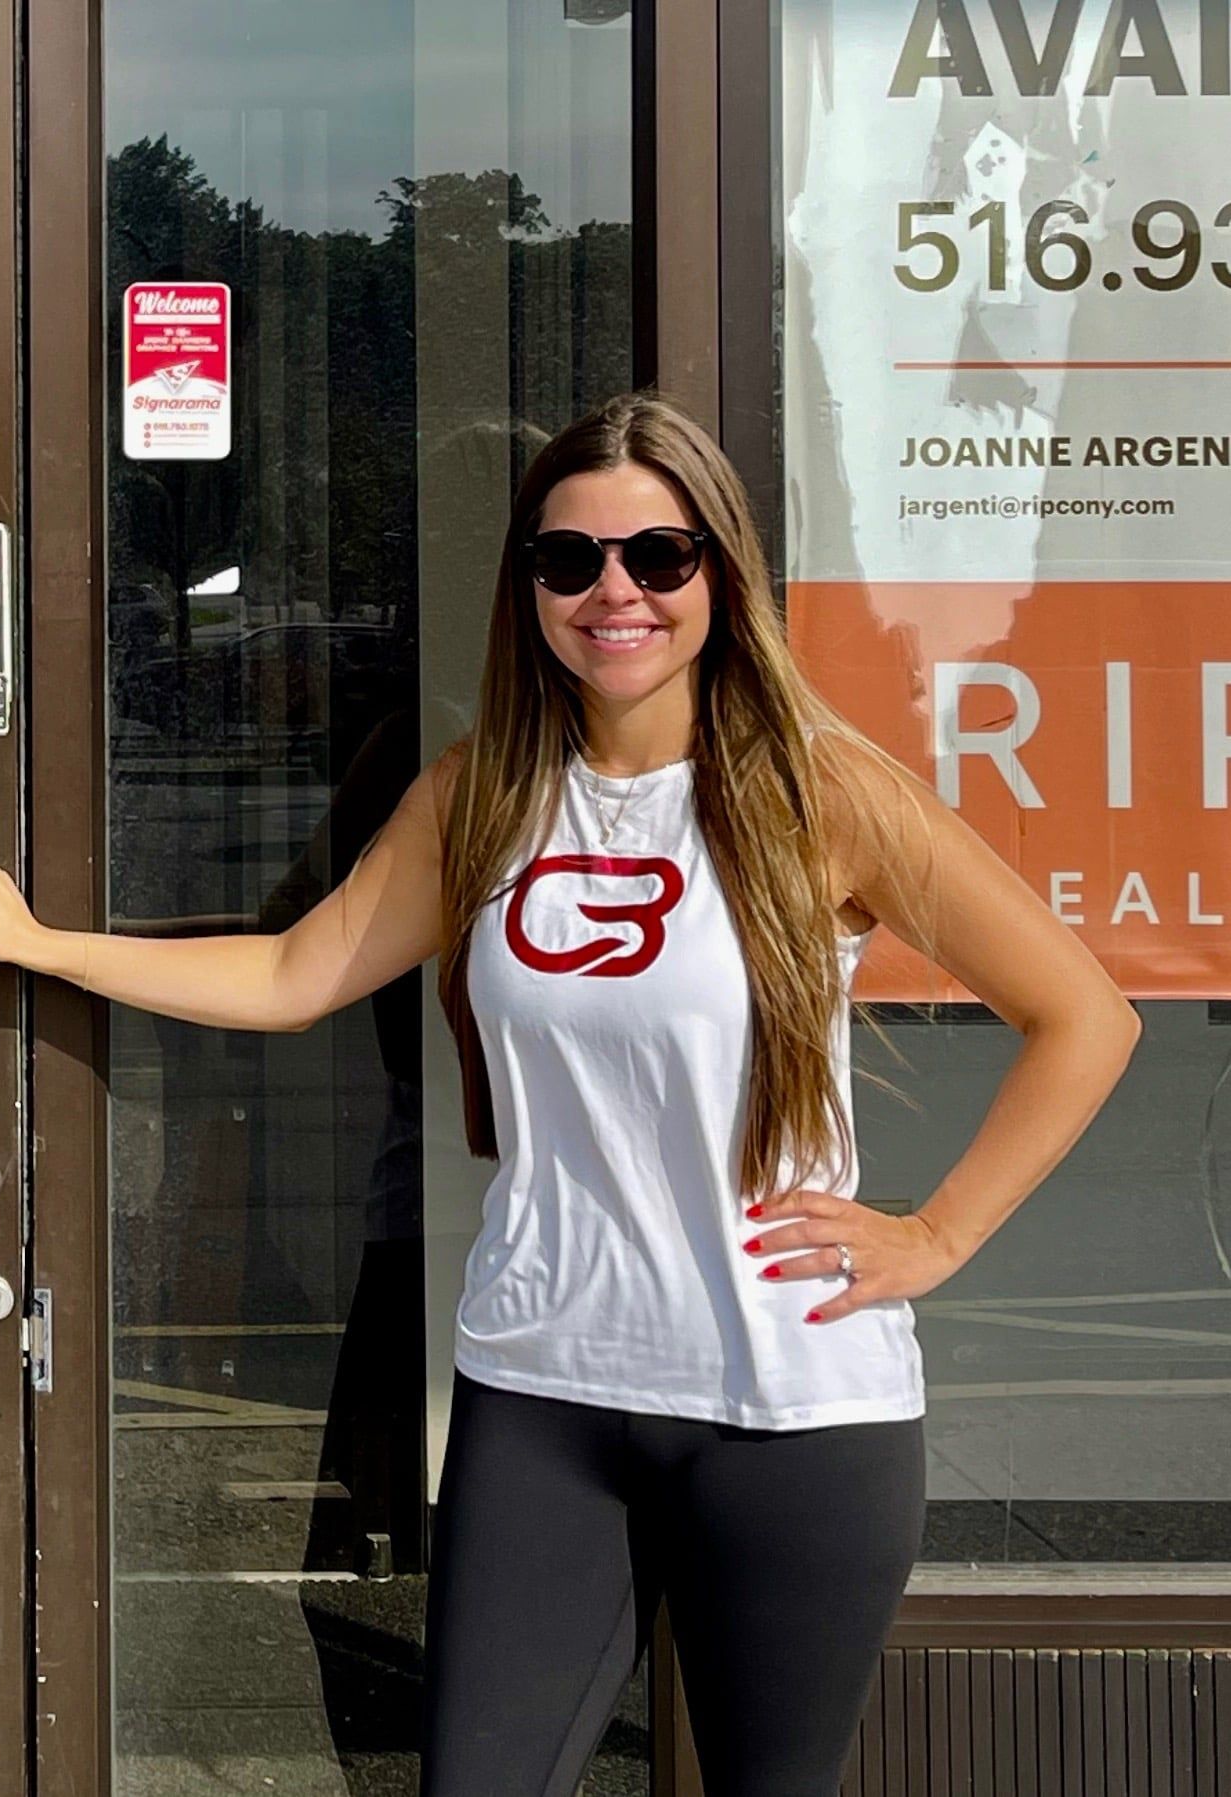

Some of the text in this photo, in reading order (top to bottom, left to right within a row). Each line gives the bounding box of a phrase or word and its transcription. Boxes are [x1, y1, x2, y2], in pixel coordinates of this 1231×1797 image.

[887, 0, 1230, 98] AVAI
[134, 291, 220, 314] Welcome
[133, 395, 221, 413] Signarama
[900, 436, 1230, 467] JOANNE ARGEN
[898, 495, 1175, 520] jargenti@ripcony.com
[1050, 871, 1224, 925] EAL
